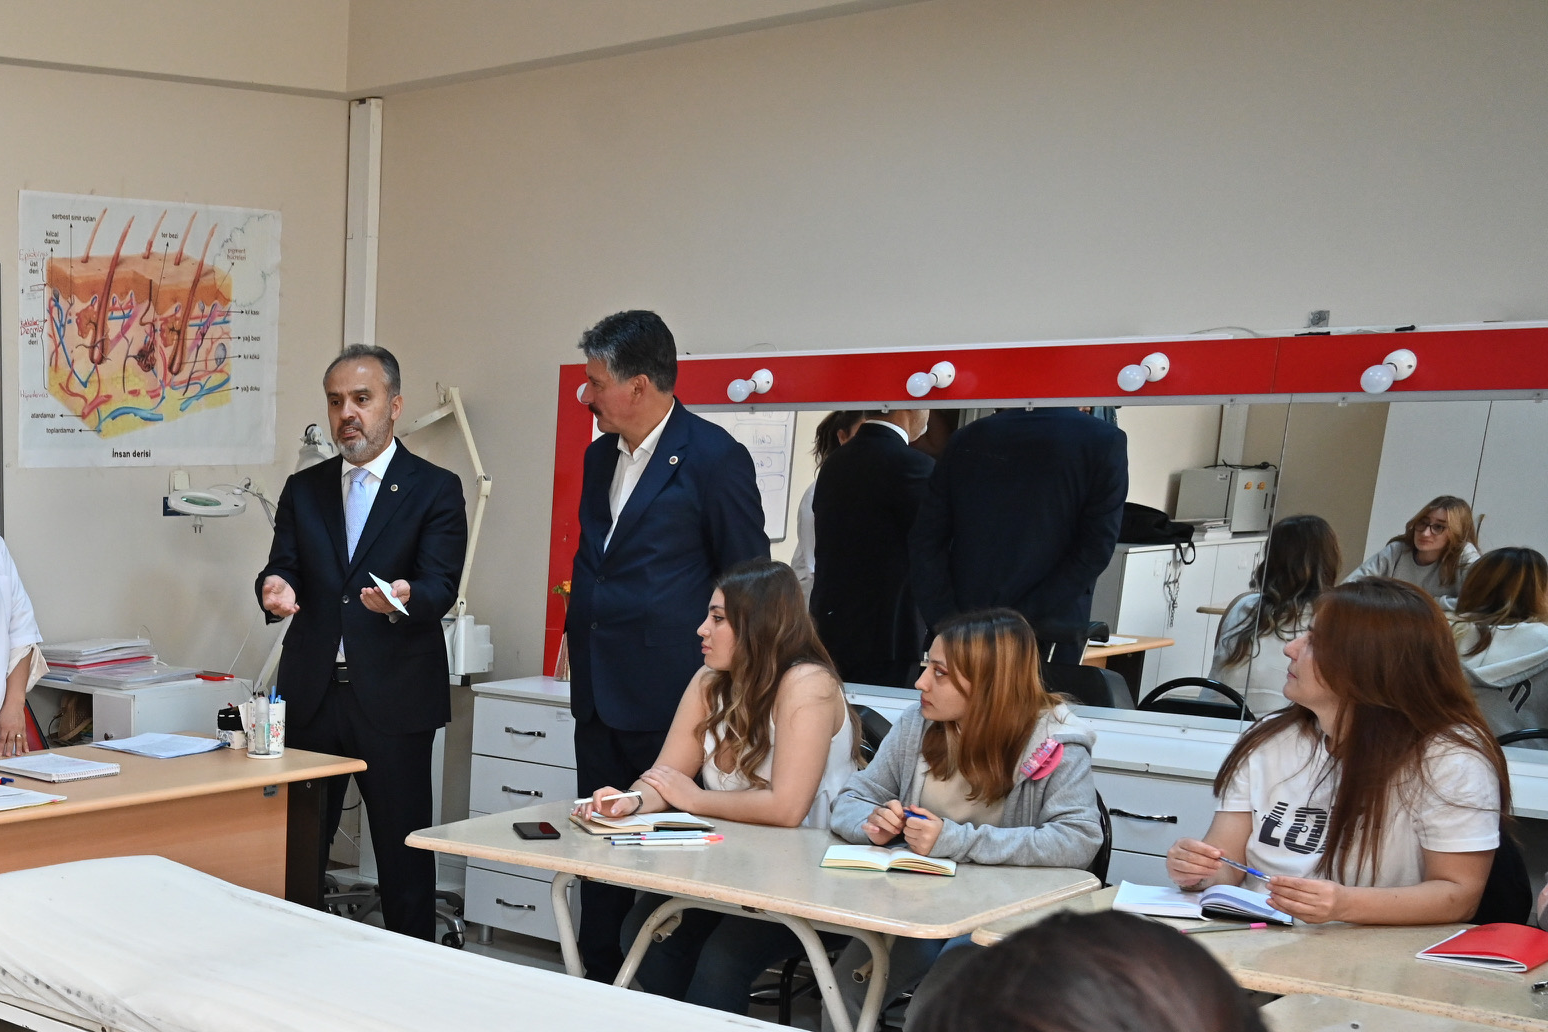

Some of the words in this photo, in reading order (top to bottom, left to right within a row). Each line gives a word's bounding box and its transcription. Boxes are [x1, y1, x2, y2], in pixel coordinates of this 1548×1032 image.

[52, 213, 71, 221] serbest
[112, 447, 131, 458] İnsan
[132, 449, 151, 458] derisi
[1258, 801, 1329, 855] LO
